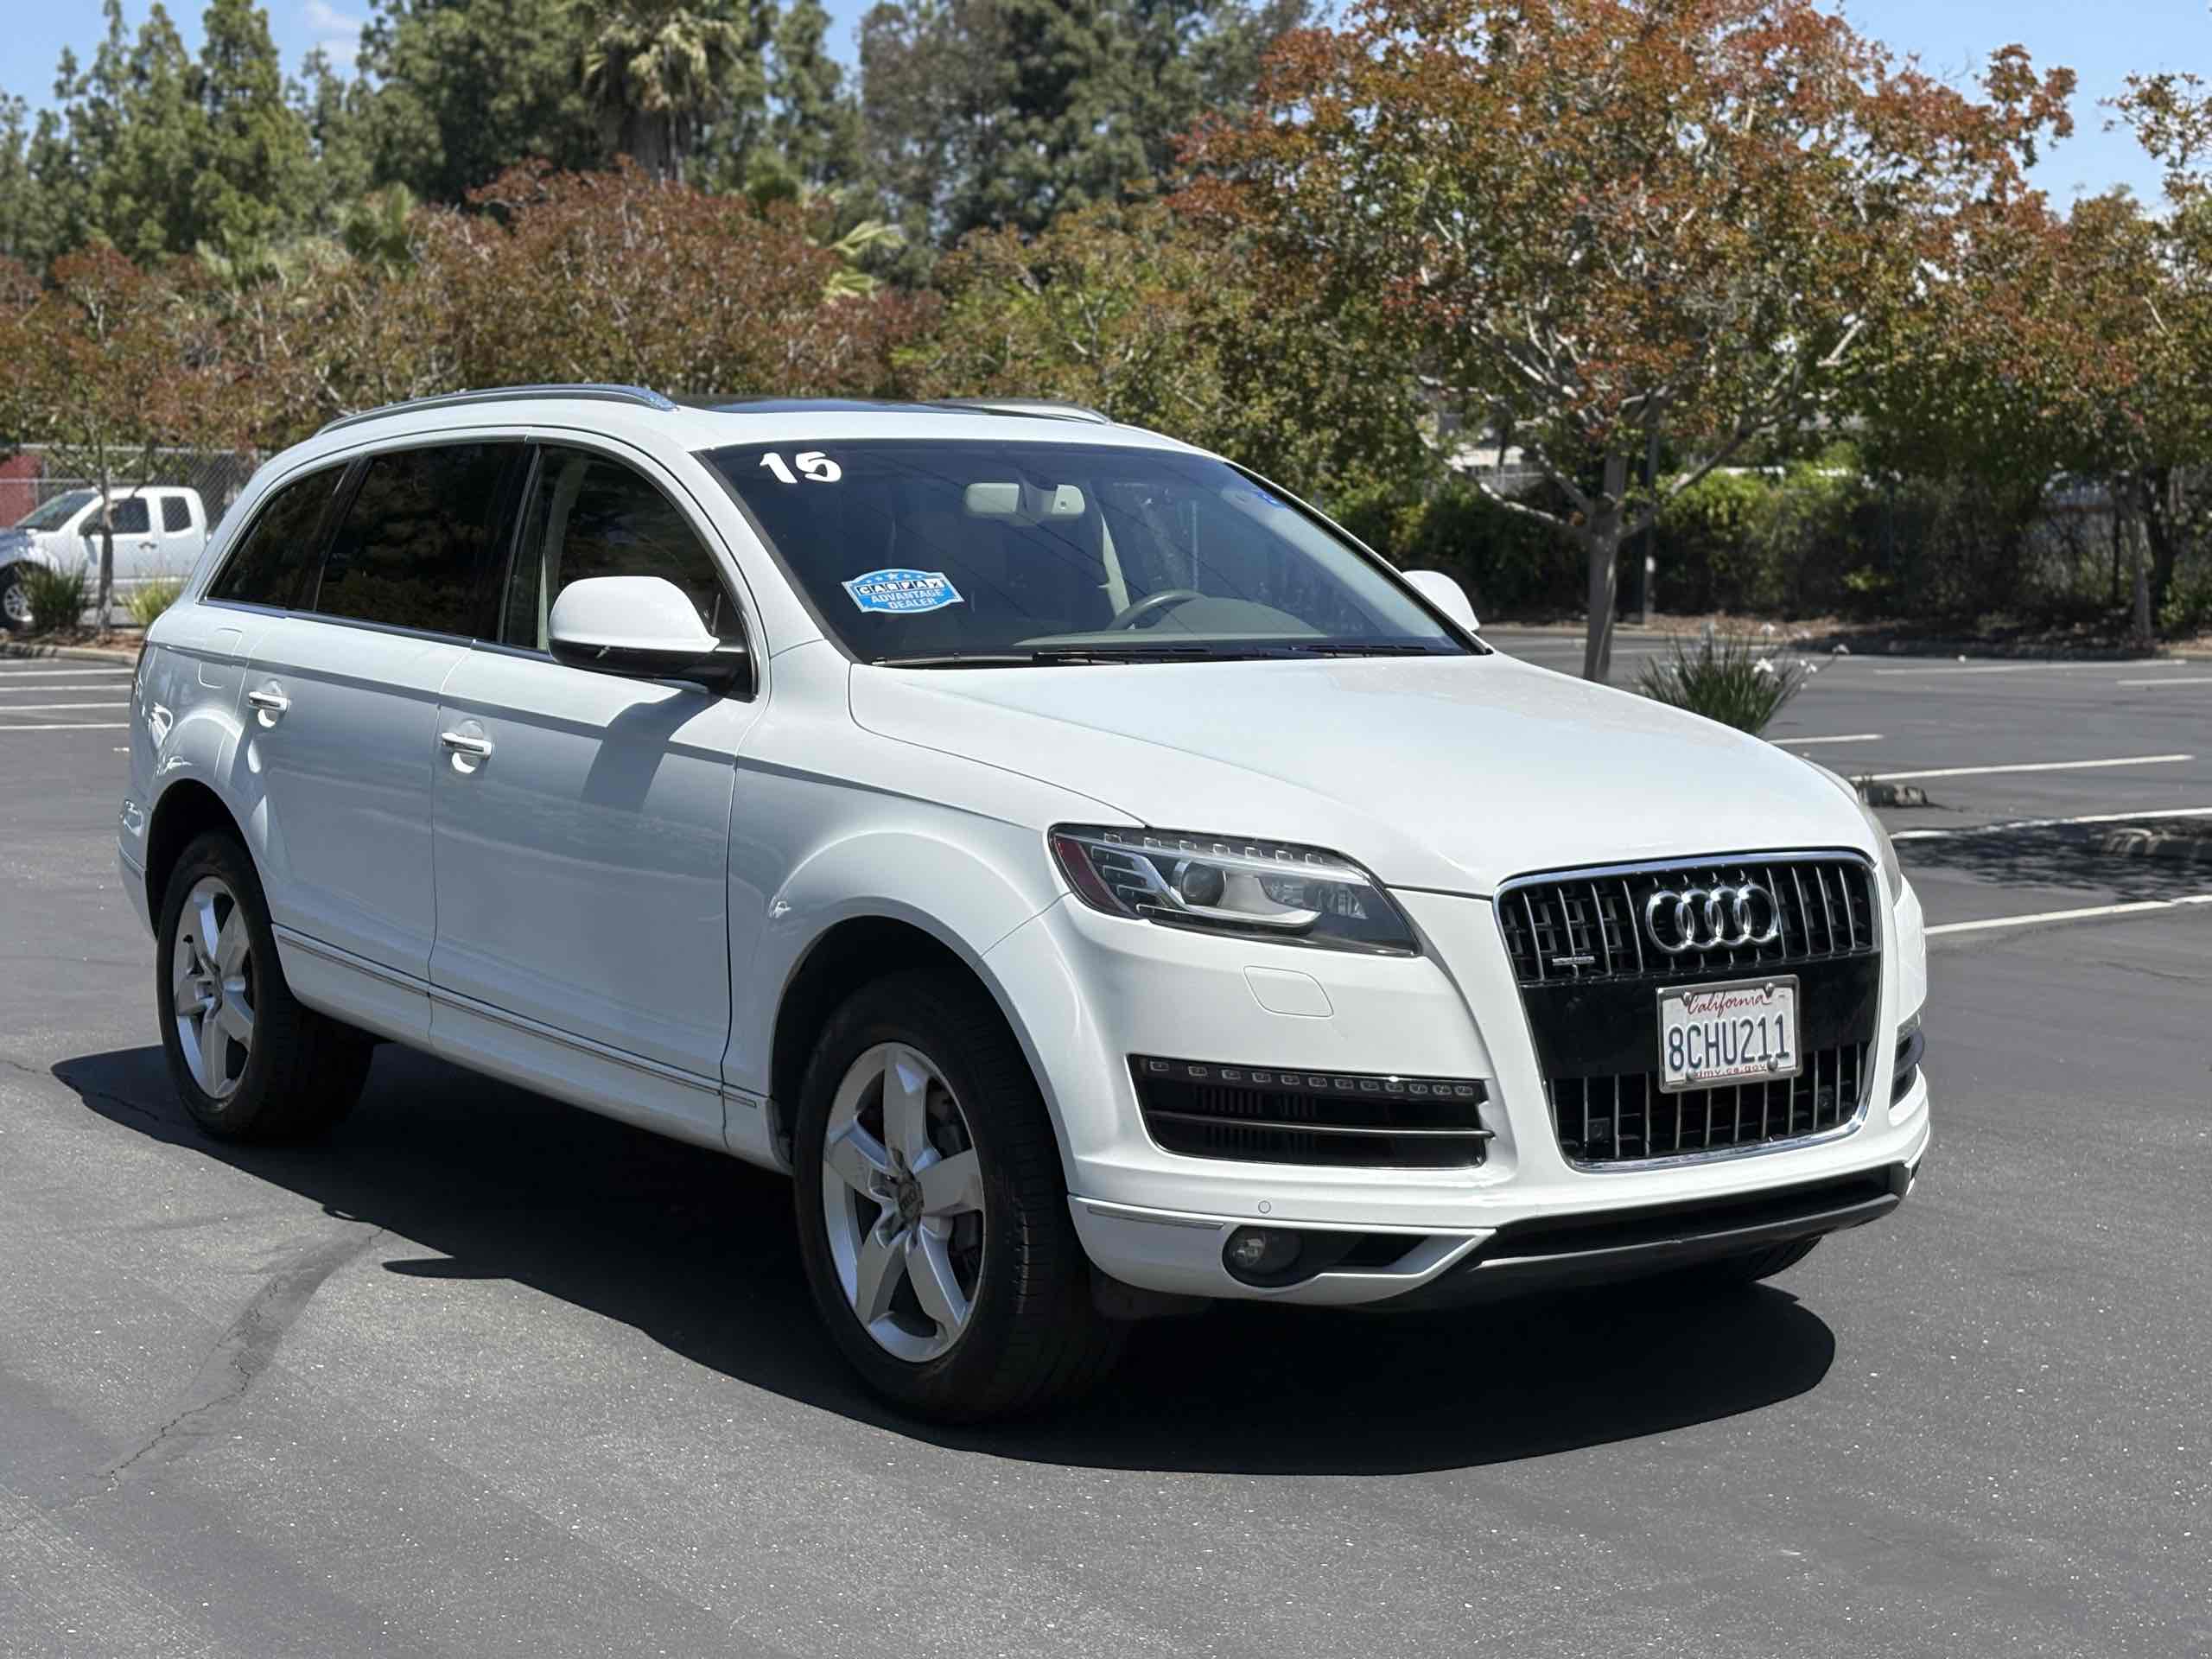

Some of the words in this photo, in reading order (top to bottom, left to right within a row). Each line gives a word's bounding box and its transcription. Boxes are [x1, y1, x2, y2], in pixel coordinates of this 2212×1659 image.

[760, 451, 842, 484] 15
[870, 588, 944, 603] ADVANTAGE
[887, 597, 937, 609] DEALER
[1688, 989, 1771, 1017] California
[1669, 1013, 1790, 1071] 8CHU211
